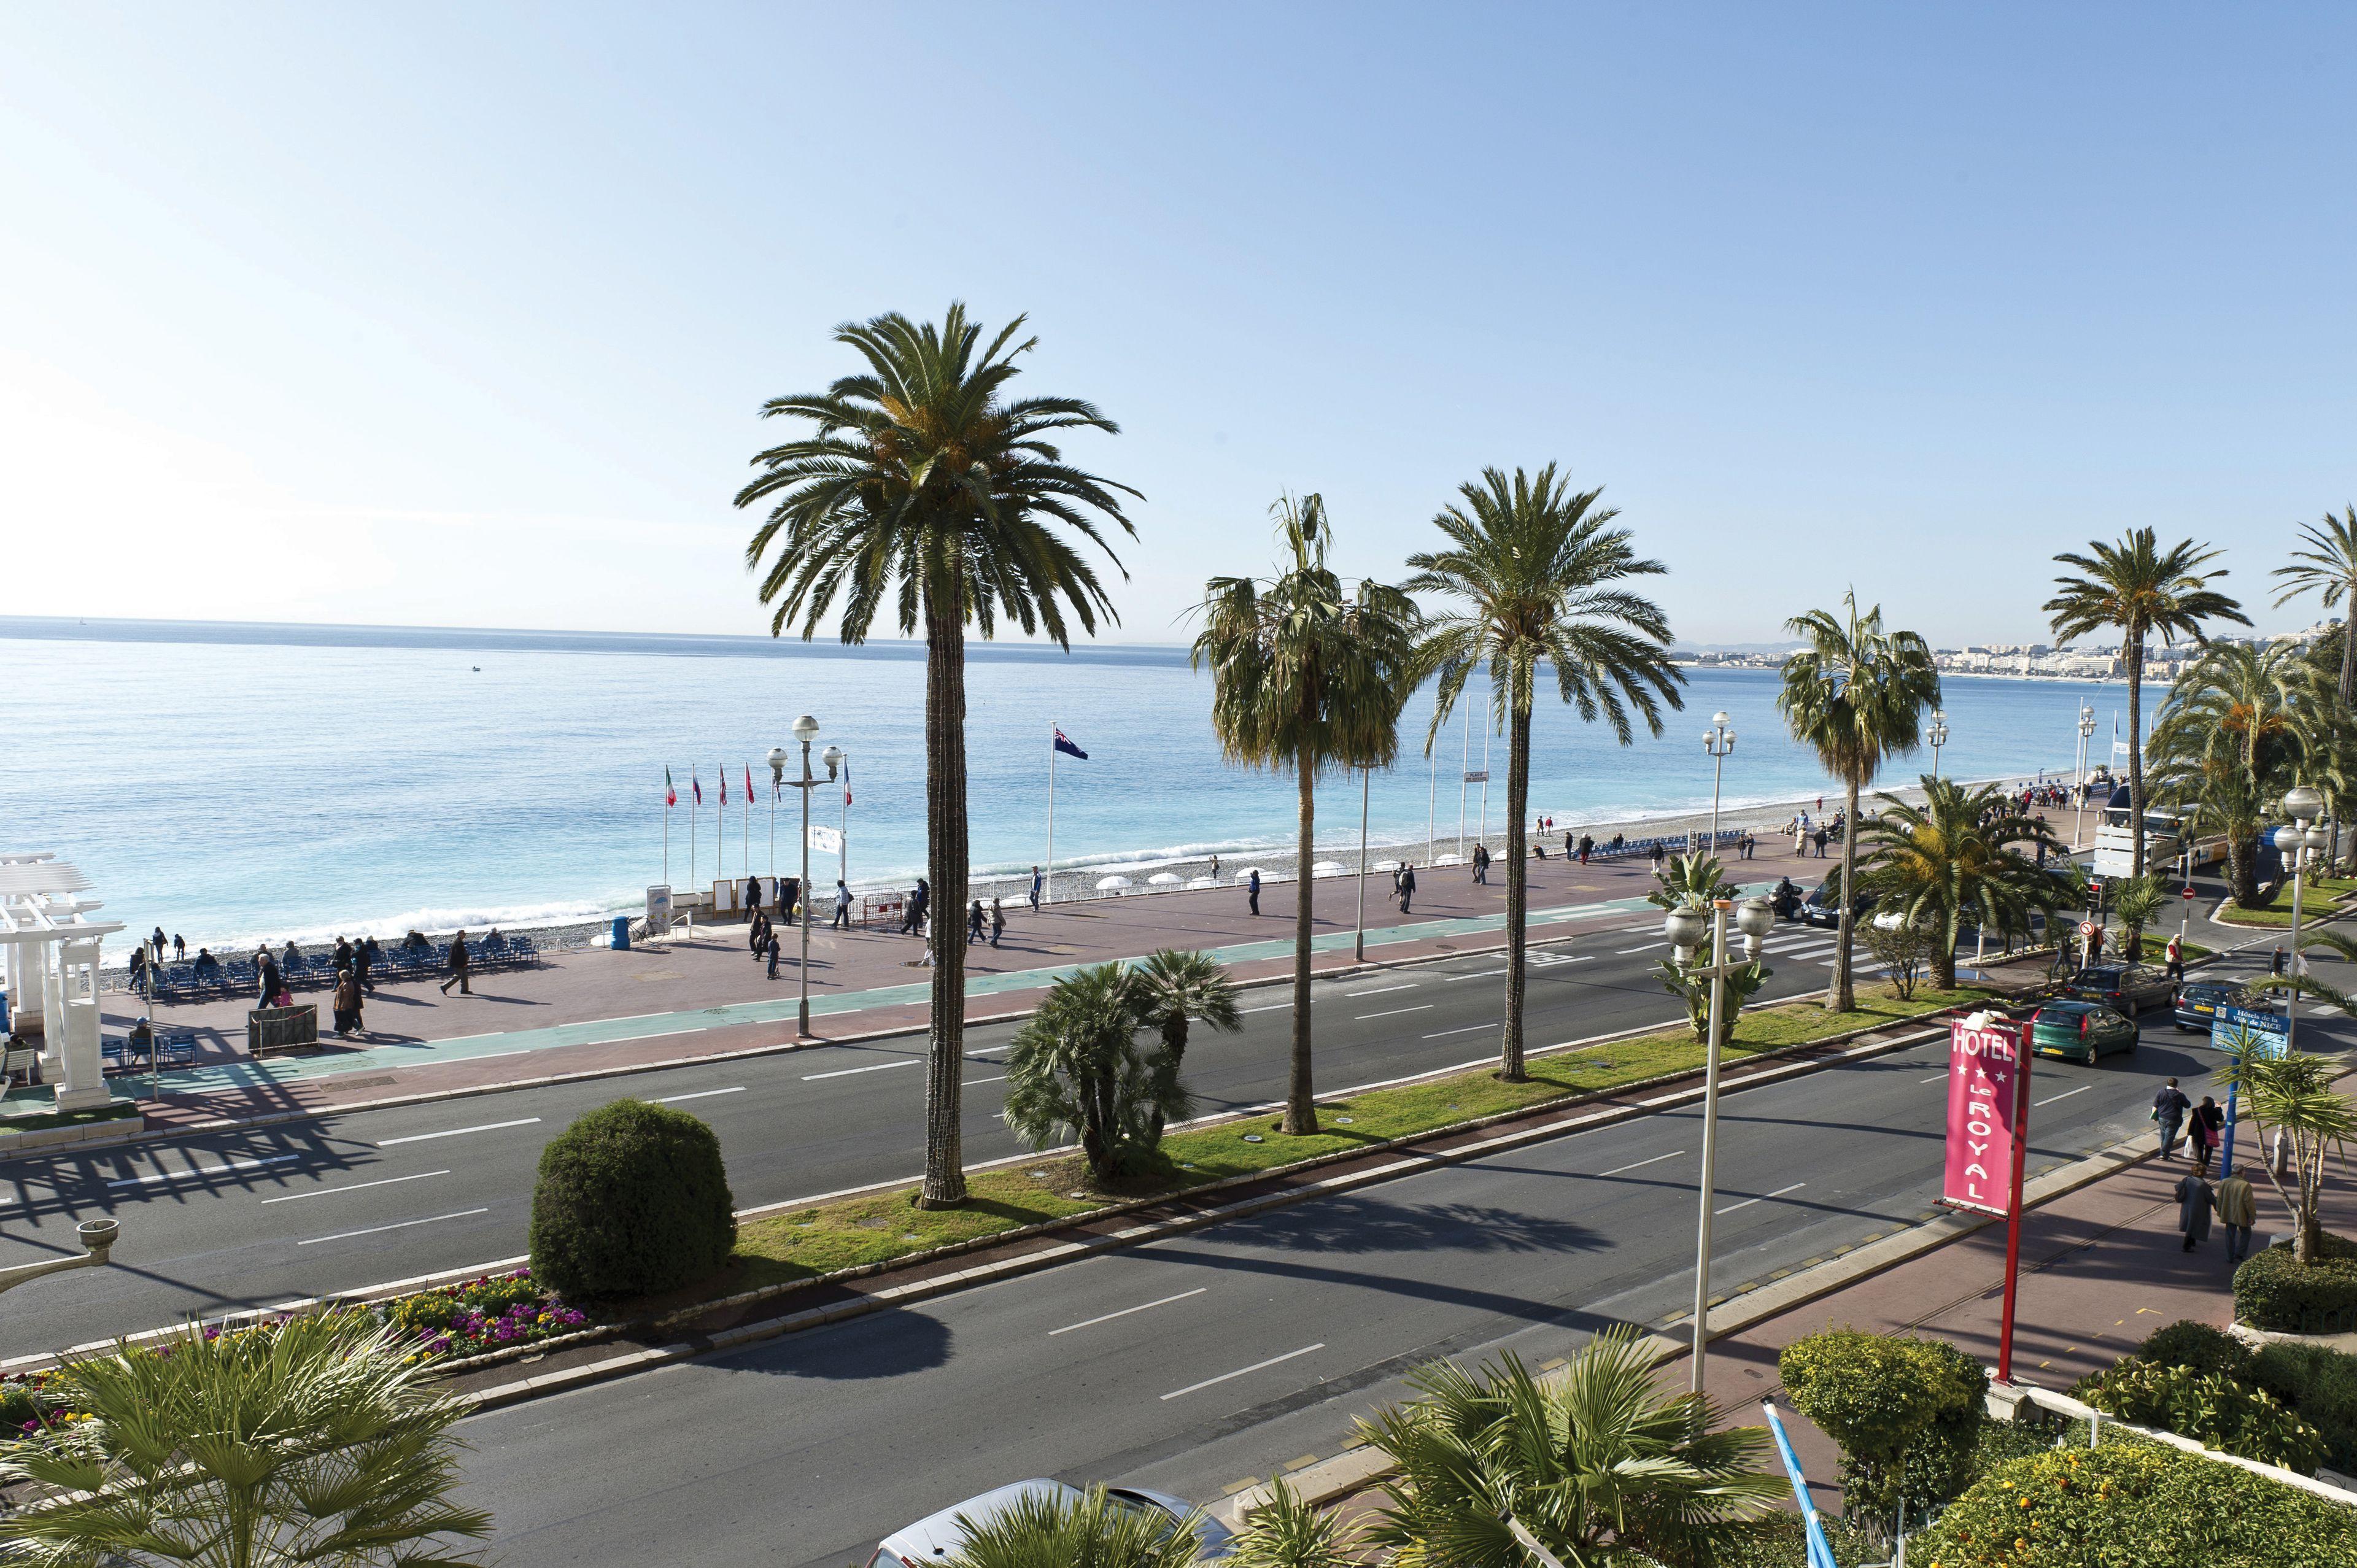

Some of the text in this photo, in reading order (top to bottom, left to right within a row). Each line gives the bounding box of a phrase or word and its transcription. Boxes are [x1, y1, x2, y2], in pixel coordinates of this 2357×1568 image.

[2233, 1015, 2247, 1024] Ville
[2260, 1021, 2282, 1030] NICE
[1953, 1028, 2012, 1062] HOTEL
[1970, 1084, 1991, 1096] Le
[1965, 1101, 1991, 1199] ROYAL
